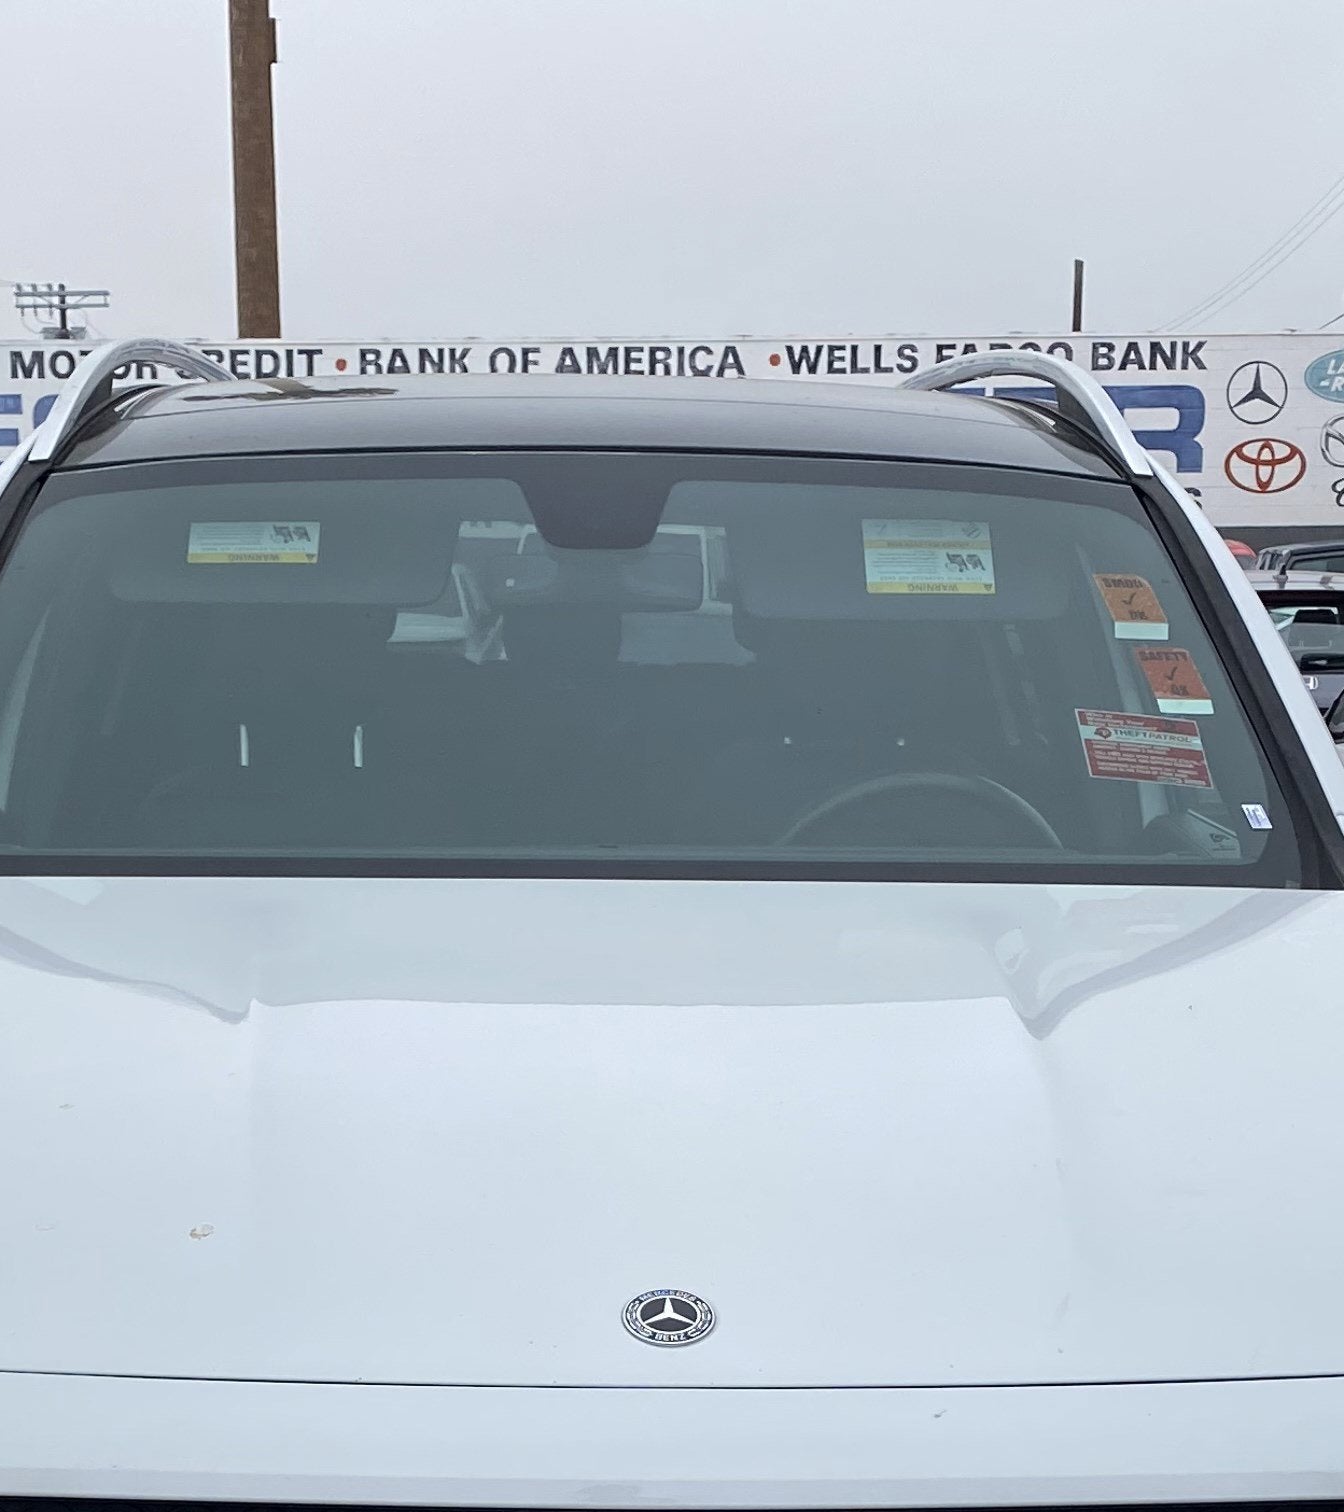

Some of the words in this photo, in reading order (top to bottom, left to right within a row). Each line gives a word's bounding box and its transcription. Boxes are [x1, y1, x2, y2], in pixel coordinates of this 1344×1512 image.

[10, 350, 158, 380] MOR
[175, 348, 323, 380] EDIT
[359, 346, 472, 375] BANK
[489, 346, 542, 375] OF
[555, 345, 746, 379] AMERICA
[785, 343, 919, 375] WELLS
[1091, 340, 1208, 371] BANK
[907, 583, 960, 593] WARNING
